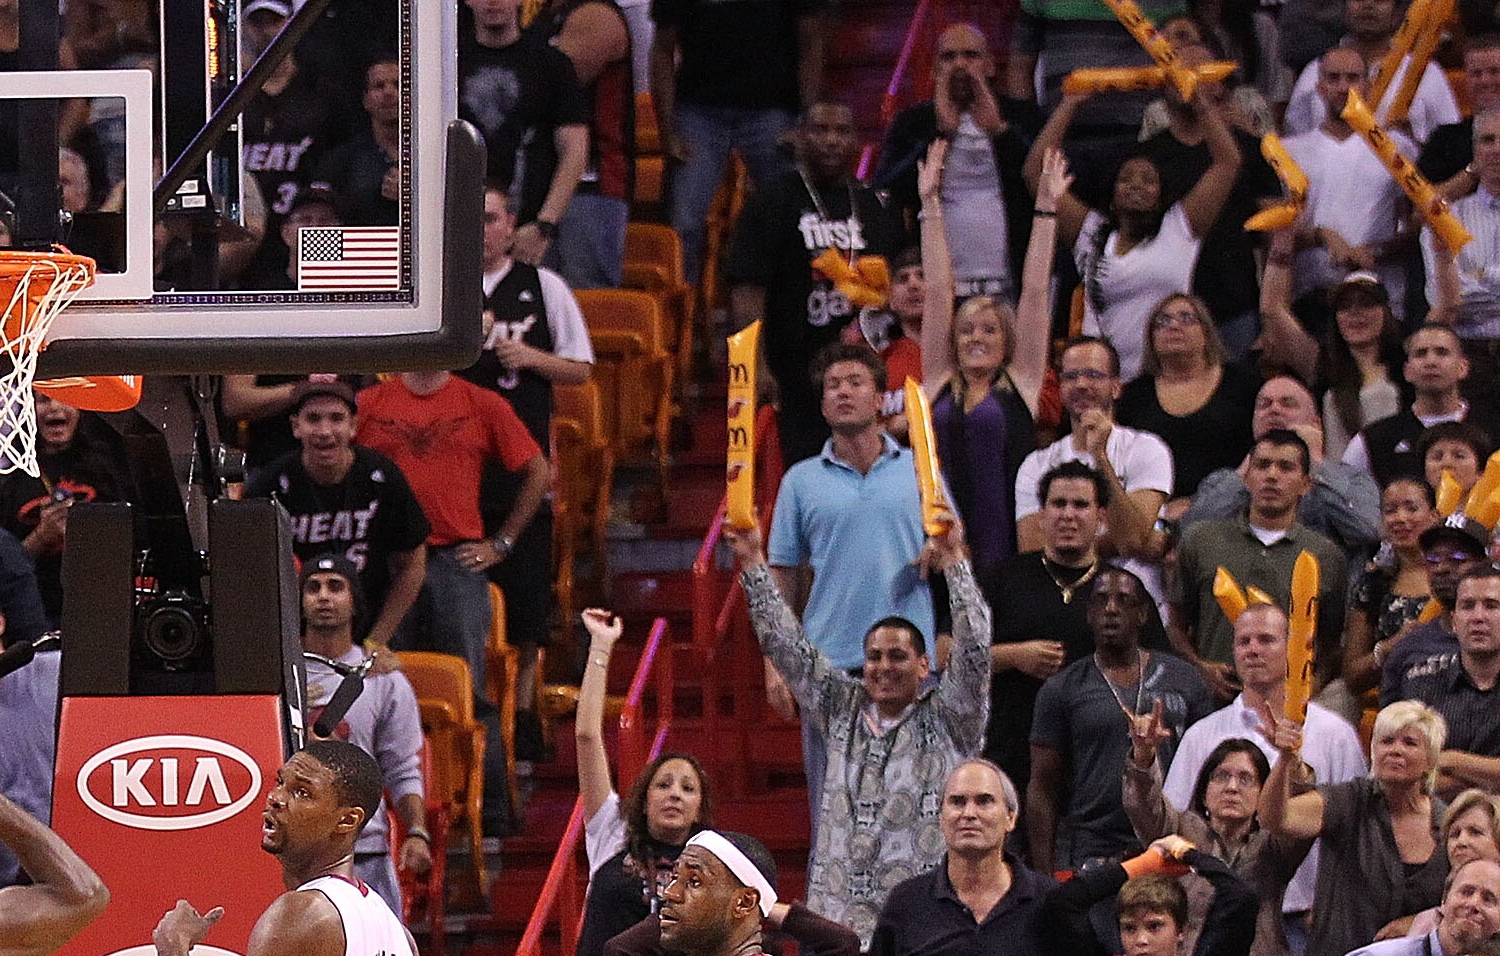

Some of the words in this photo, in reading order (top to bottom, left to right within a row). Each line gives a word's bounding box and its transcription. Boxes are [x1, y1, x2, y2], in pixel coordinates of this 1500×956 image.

[271, 181, 299, 216] 3
[798, 212, 867, 250] first
[290, 499, 380, 543] HEAT
[111, 757, 232, 807] KIA
